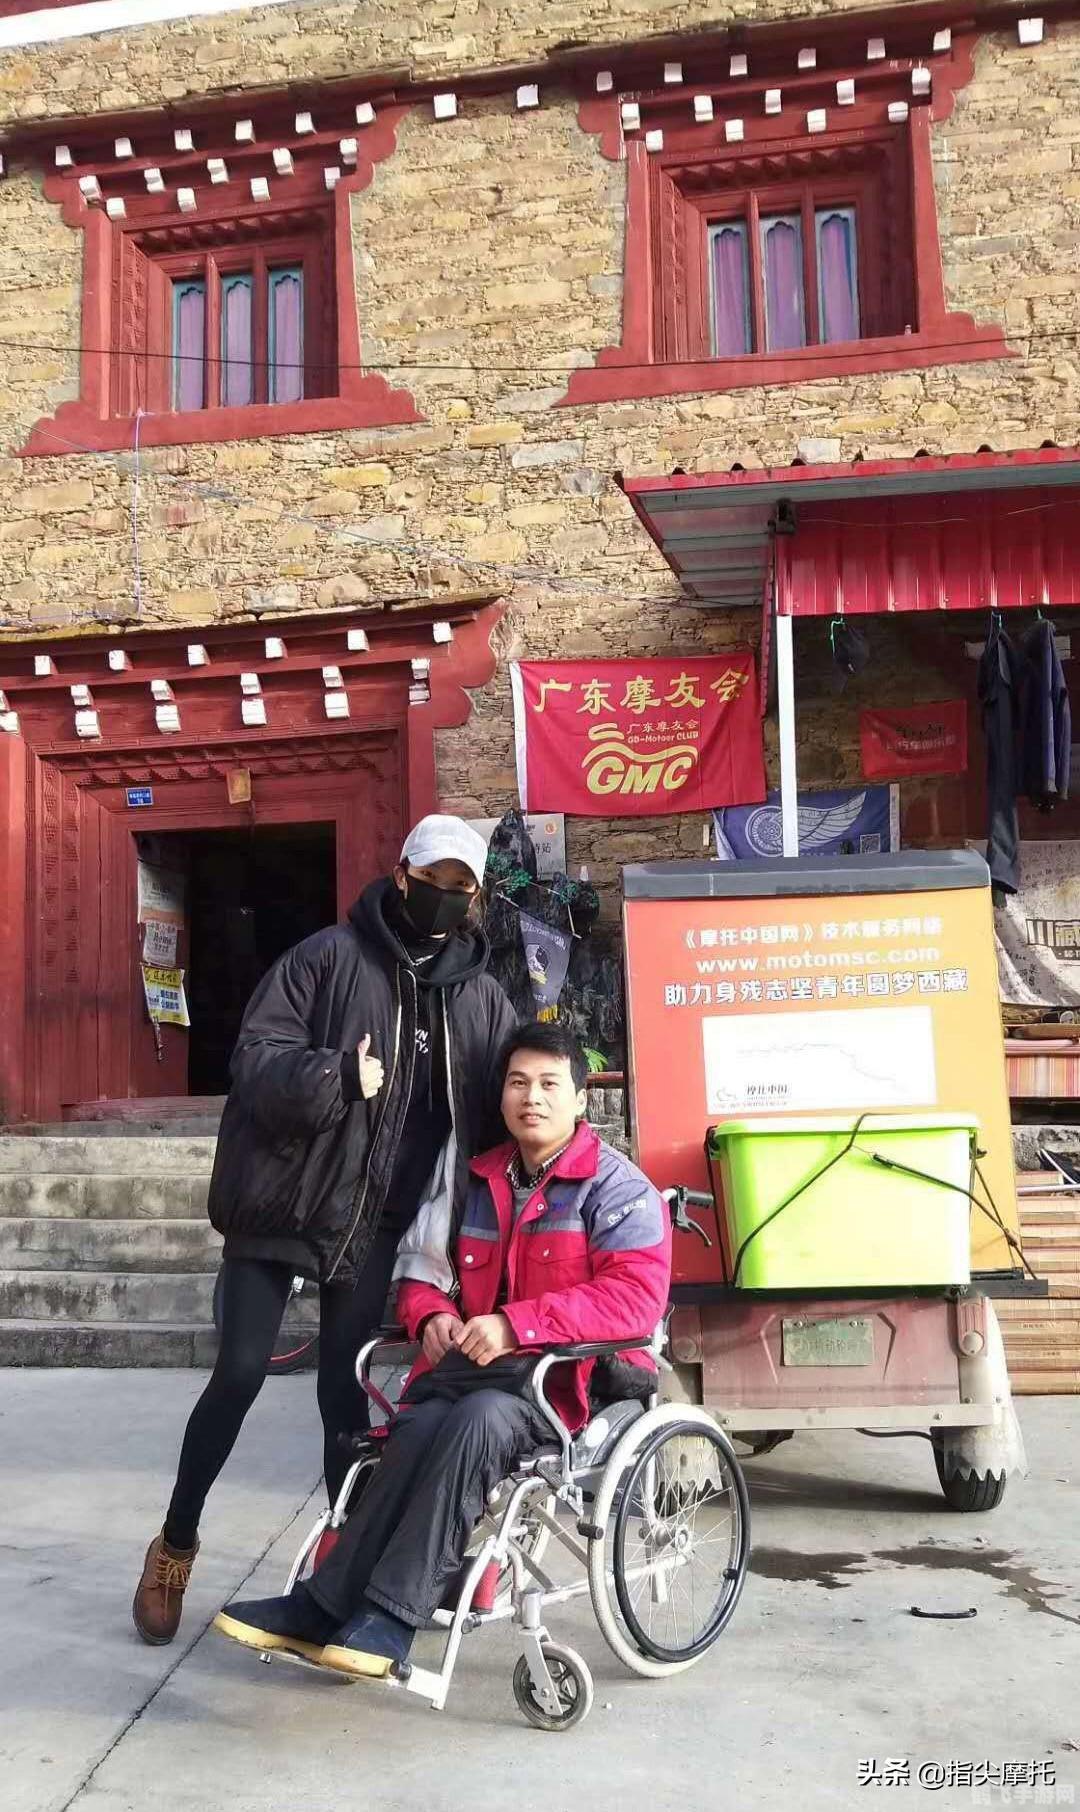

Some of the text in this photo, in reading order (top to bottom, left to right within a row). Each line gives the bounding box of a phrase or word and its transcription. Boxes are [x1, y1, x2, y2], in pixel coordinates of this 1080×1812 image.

[535, 668, 749, 714] 广东摩友会
[627, 719, 699, 734] 广东摩友会
[676, 731, 699, 740] CLUB
[587, 756, 692, 795] GMC
[695, 945, 940, 973] www.motomsc.com
[664, 968, 969, 1007] 助力身残志坚青年圆梦西藏
